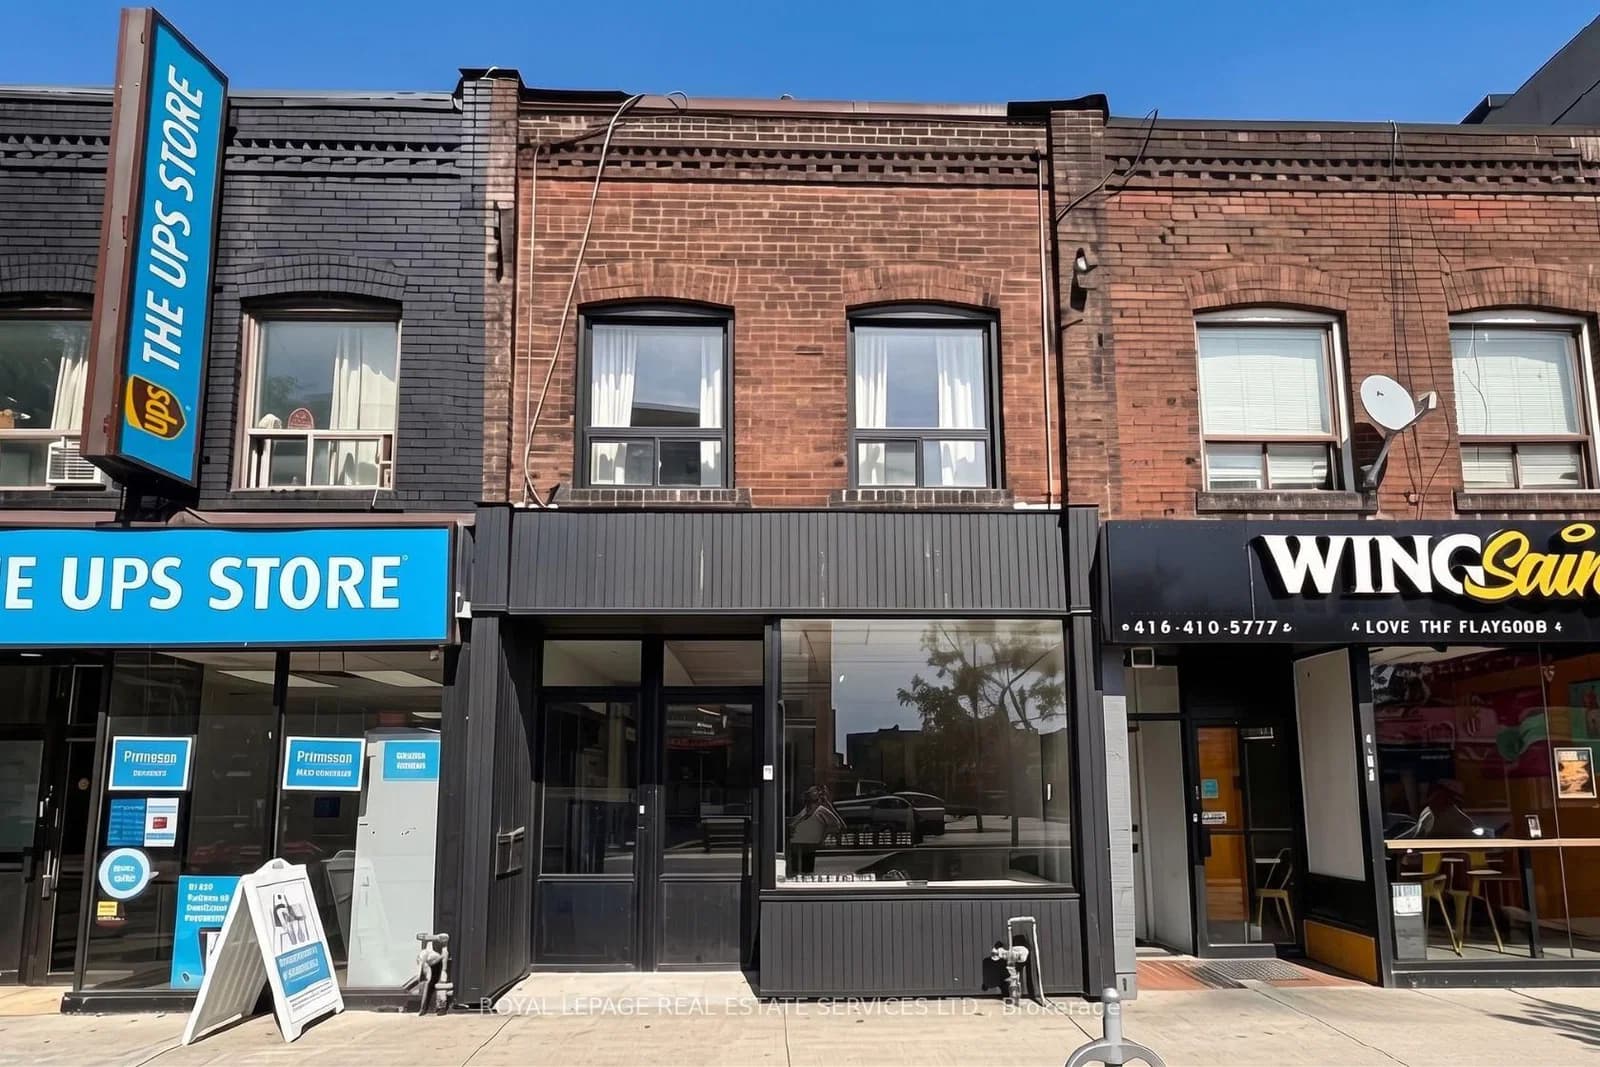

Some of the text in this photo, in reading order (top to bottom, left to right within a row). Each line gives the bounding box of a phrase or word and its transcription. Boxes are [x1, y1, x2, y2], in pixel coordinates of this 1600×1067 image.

[143, 64, 204, 369] THE UPS STORE
[143, 384, 179, 437] ups
[61, 556, 183, 611] UPS
[209, 556, 402, 611] STORE
[1262, 534, 1485, 595] WING
[1365, 619, 1410, 635] LOVE
